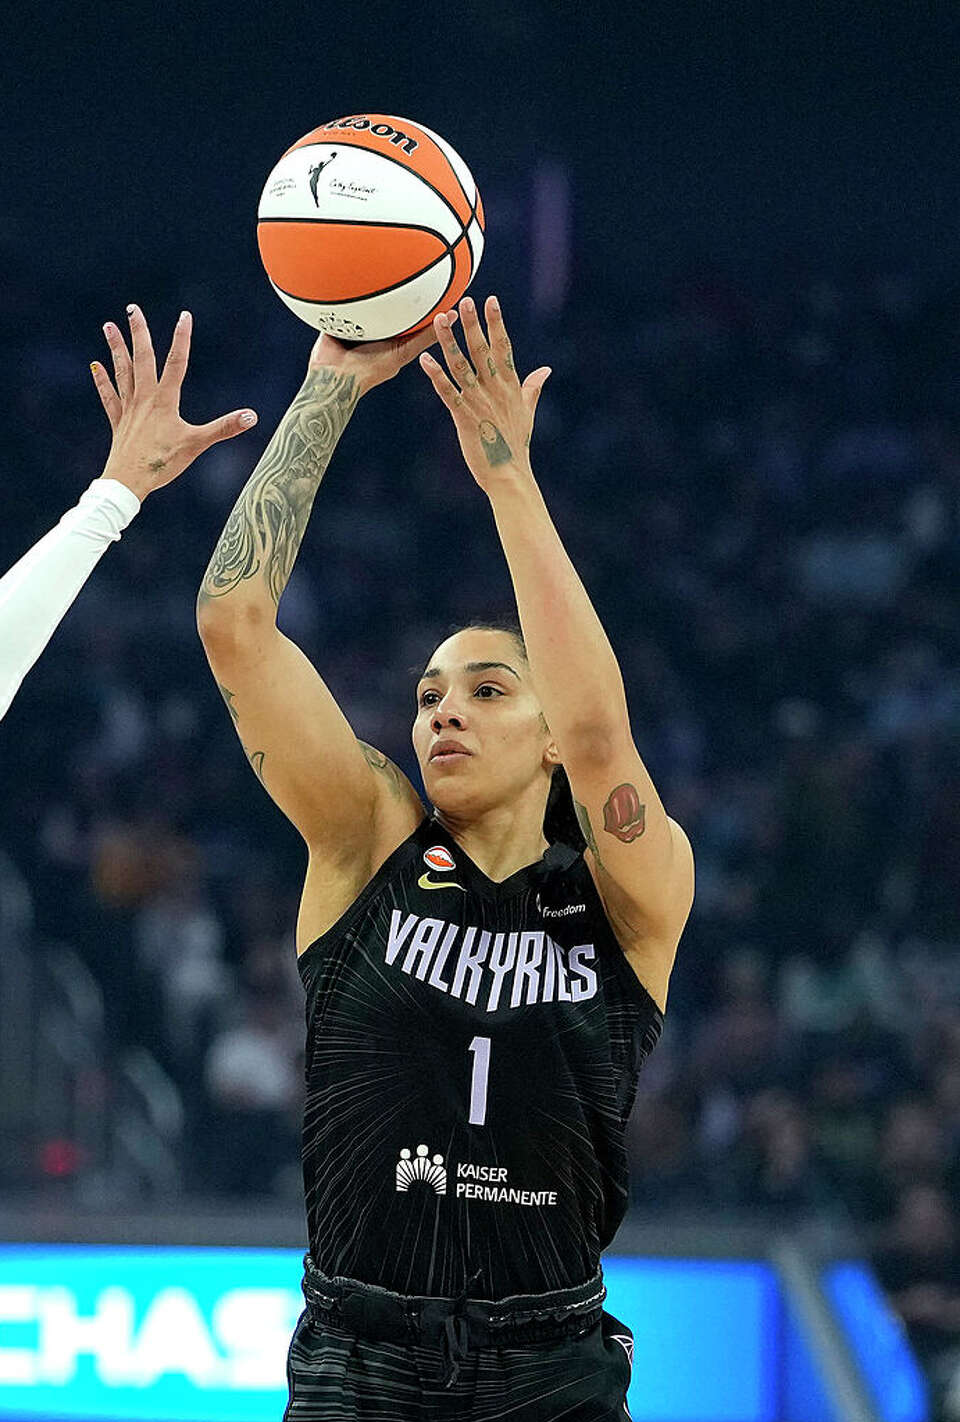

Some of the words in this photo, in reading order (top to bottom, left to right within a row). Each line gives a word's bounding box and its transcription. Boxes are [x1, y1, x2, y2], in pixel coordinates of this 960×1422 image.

[542, 904, 586, 918] freedom
[468, 1036, 491, 1126] 1
[456, 1162, 508, 1183] KAISER
[456, 1183, 559, 1206] PERMANENTE
